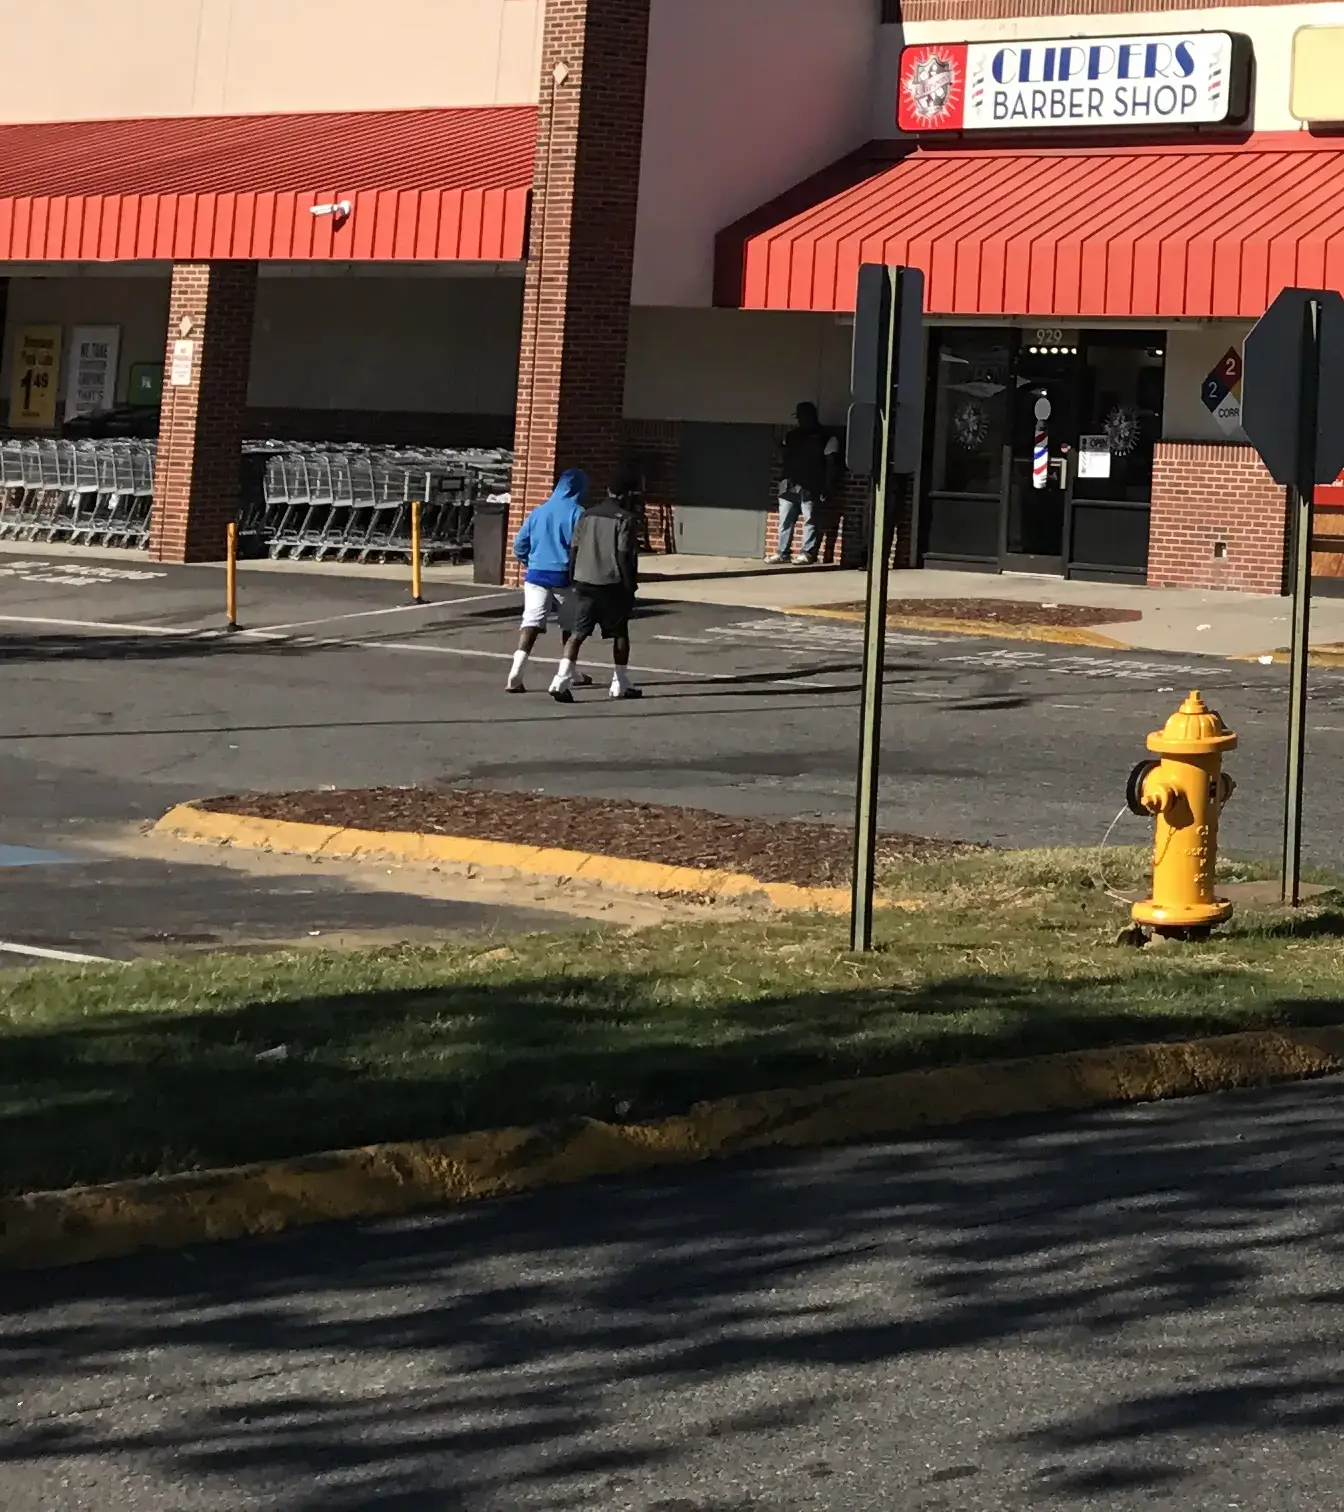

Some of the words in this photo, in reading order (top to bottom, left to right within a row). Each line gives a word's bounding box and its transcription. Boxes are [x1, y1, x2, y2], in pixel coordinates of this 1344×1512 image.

[992, 40, 1195, 84] CLIPPERS
[993, 87, 1104, 121] BARBER
[1113, 85, 1197, 117] SHOP
[1036, 329, 1062, 345] 929
[1226, 358, 1236, 376] 2
[1208, 382, 1218, 398] 2
